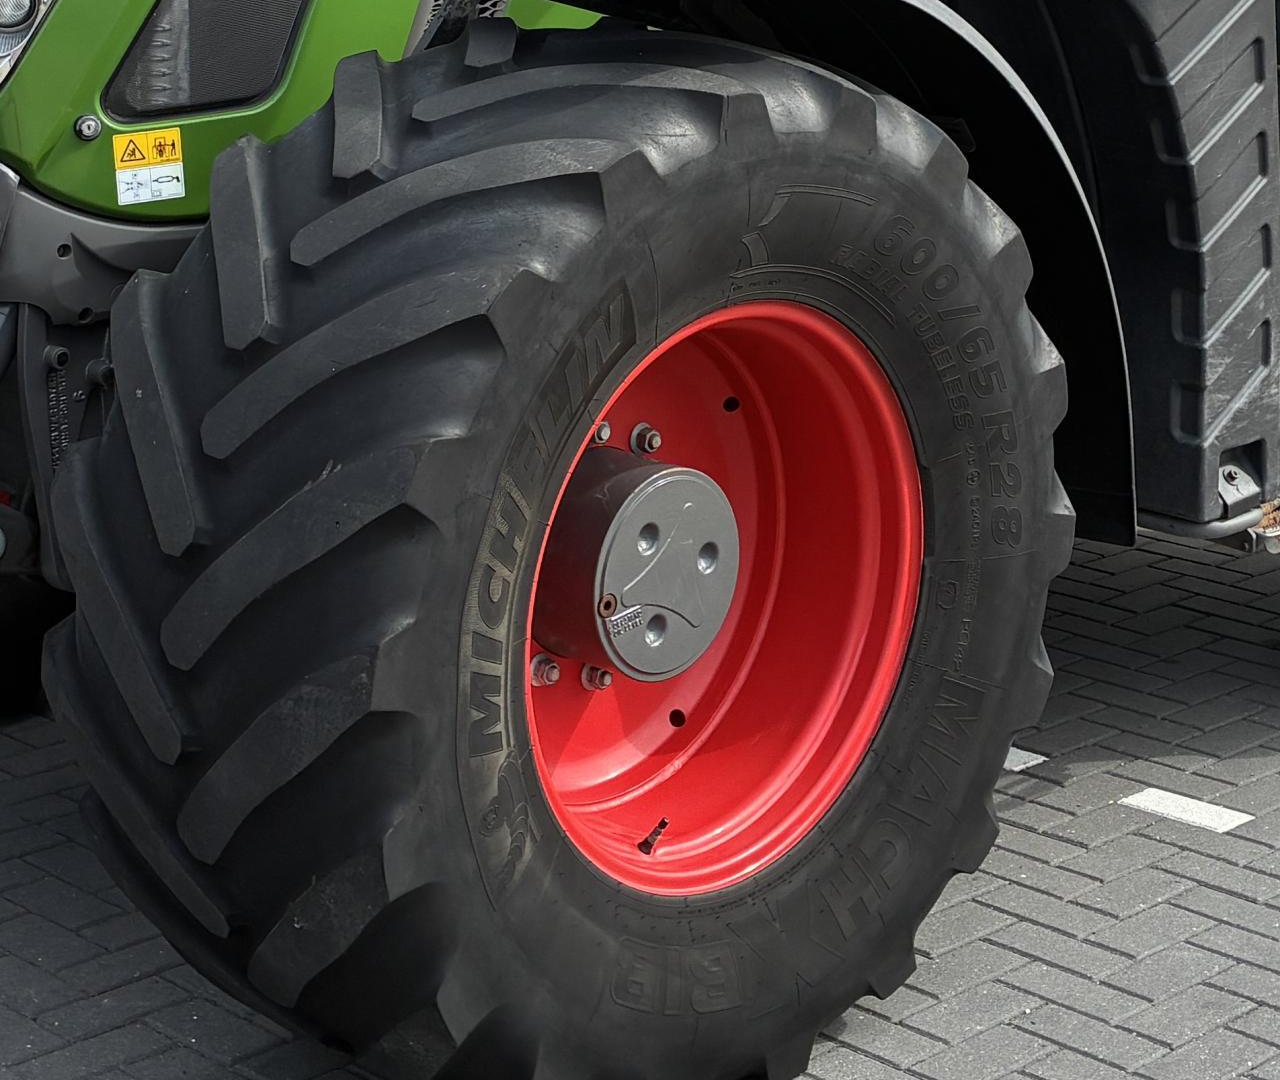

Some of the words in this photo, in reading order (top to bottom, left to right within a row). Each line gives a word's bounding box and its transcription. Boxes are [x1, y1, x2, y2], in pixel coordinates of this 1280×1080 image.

[829, 242, 911, 306] RADIAL
[904, 303, 976, 432] TUBELESS
[468, 291, 629, 758] MICHELIN
